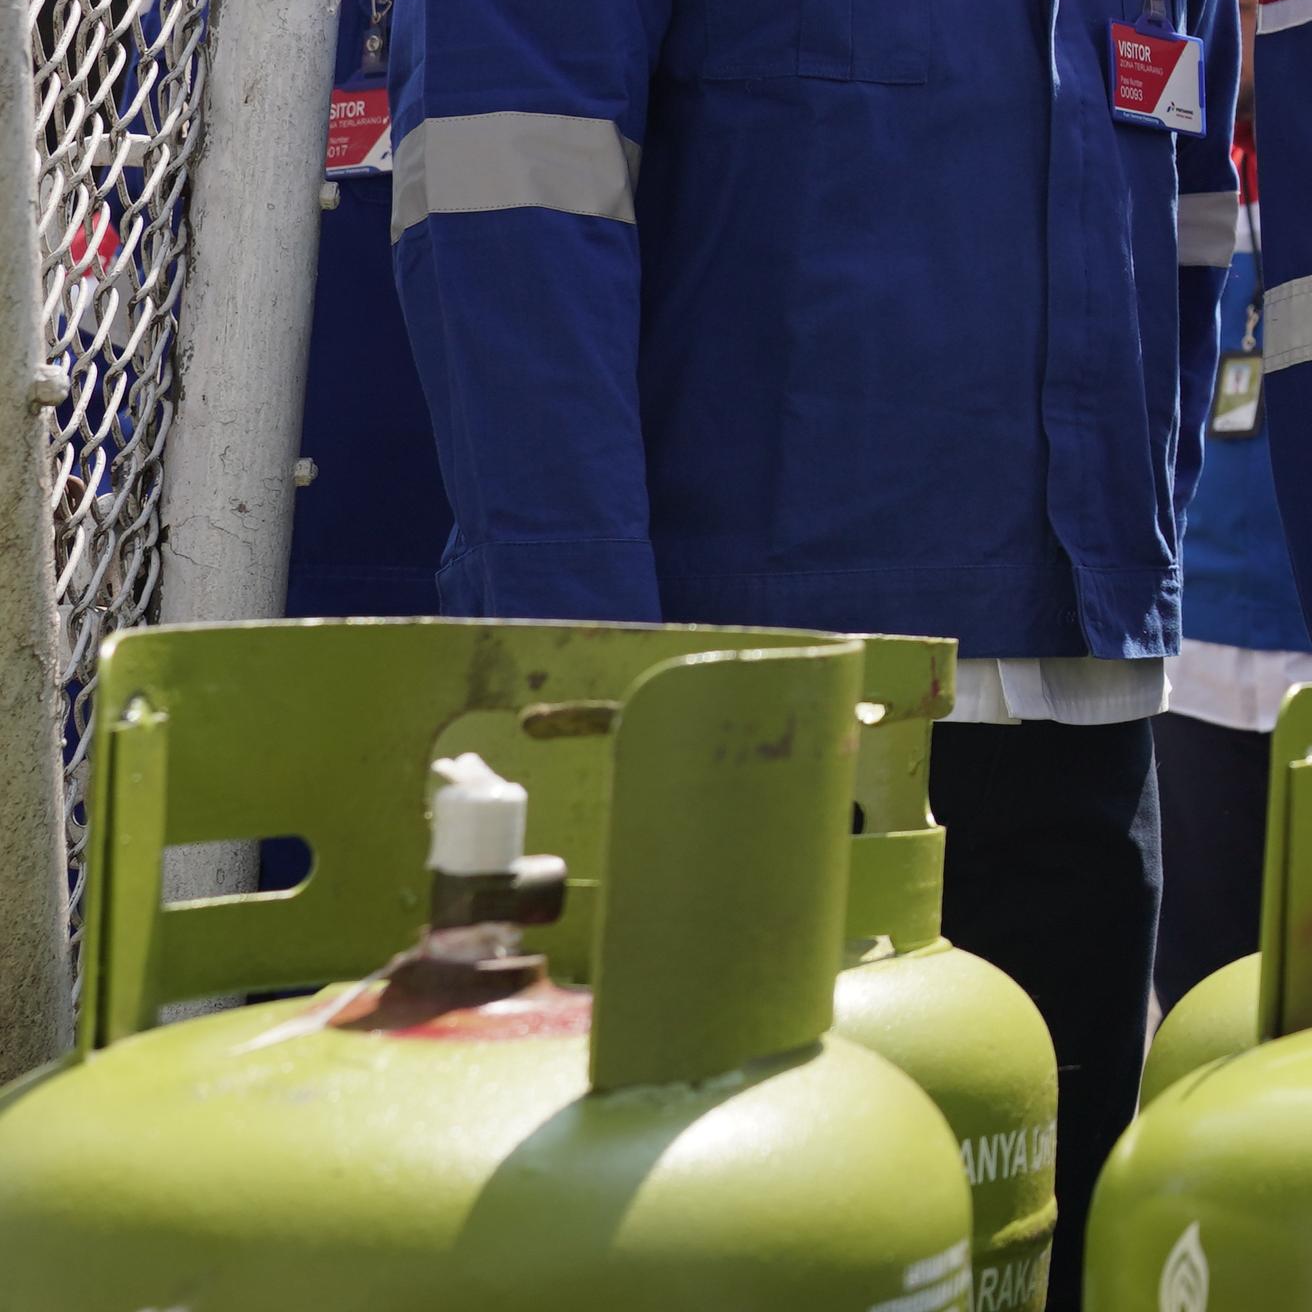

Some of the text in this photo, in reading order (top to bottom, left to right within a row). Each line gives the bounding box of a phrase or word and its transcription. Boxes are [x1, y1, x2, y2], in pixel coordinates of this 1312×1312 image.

[1118, 39, 1152, 63] VISITOR
[1120, 85, 1143, 101] 00093
[329, 100, 366, 120] SITOR
[327, 145, 349, 158] 017
